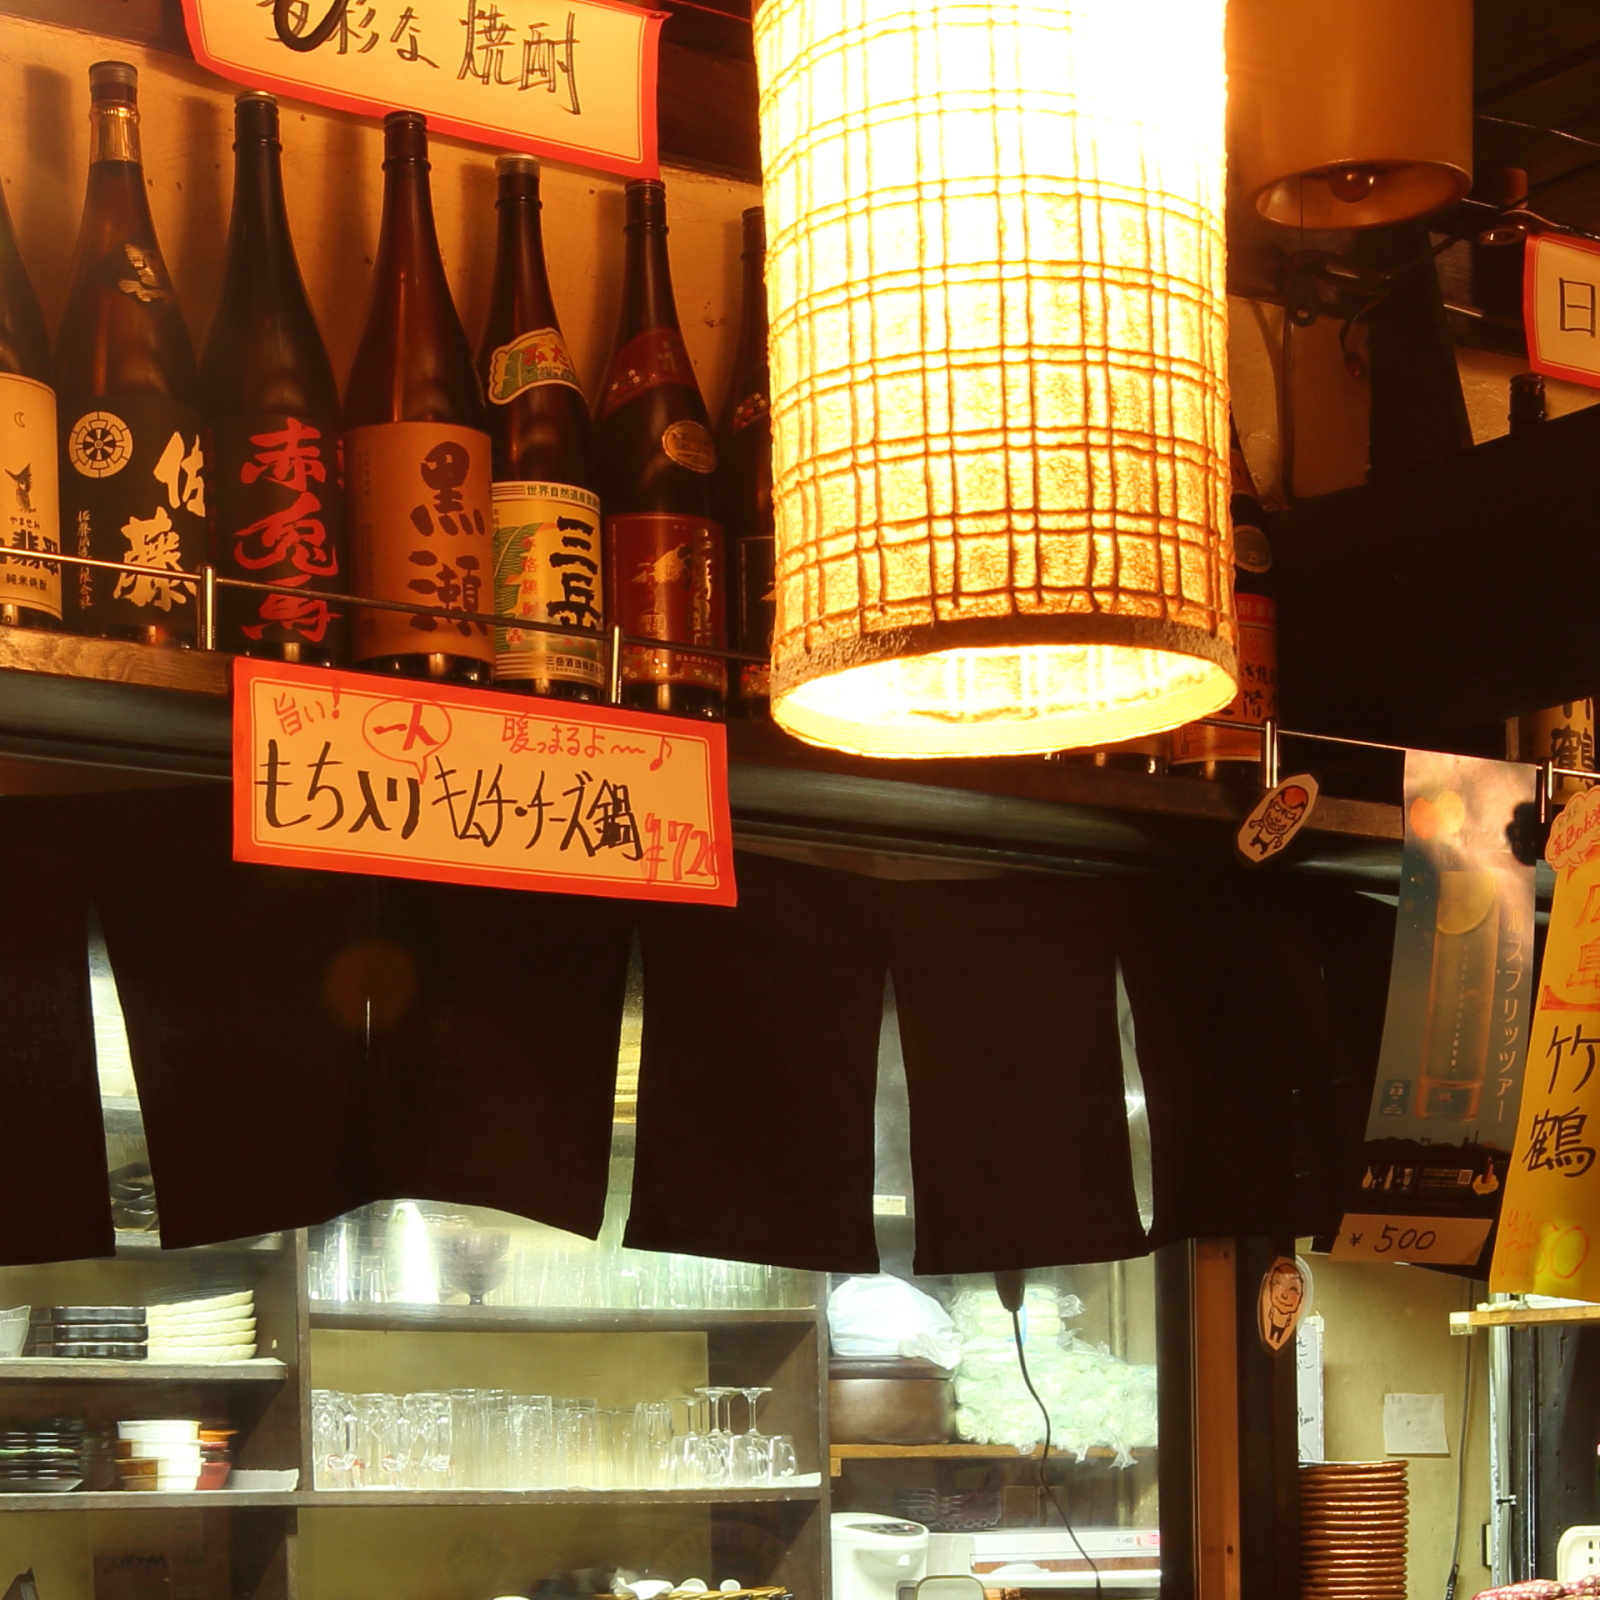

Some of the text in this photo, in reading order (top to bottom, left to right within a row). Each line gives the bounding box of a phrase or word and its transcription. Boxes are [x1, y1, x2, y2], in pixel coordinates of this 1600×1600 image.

[10, 516, 40, 530] やませみ
[407, 440, 488, 637] 黒瀬
[371, 702, 440, 751] 一人
[1373, 1224, 1437, 1252] 500
